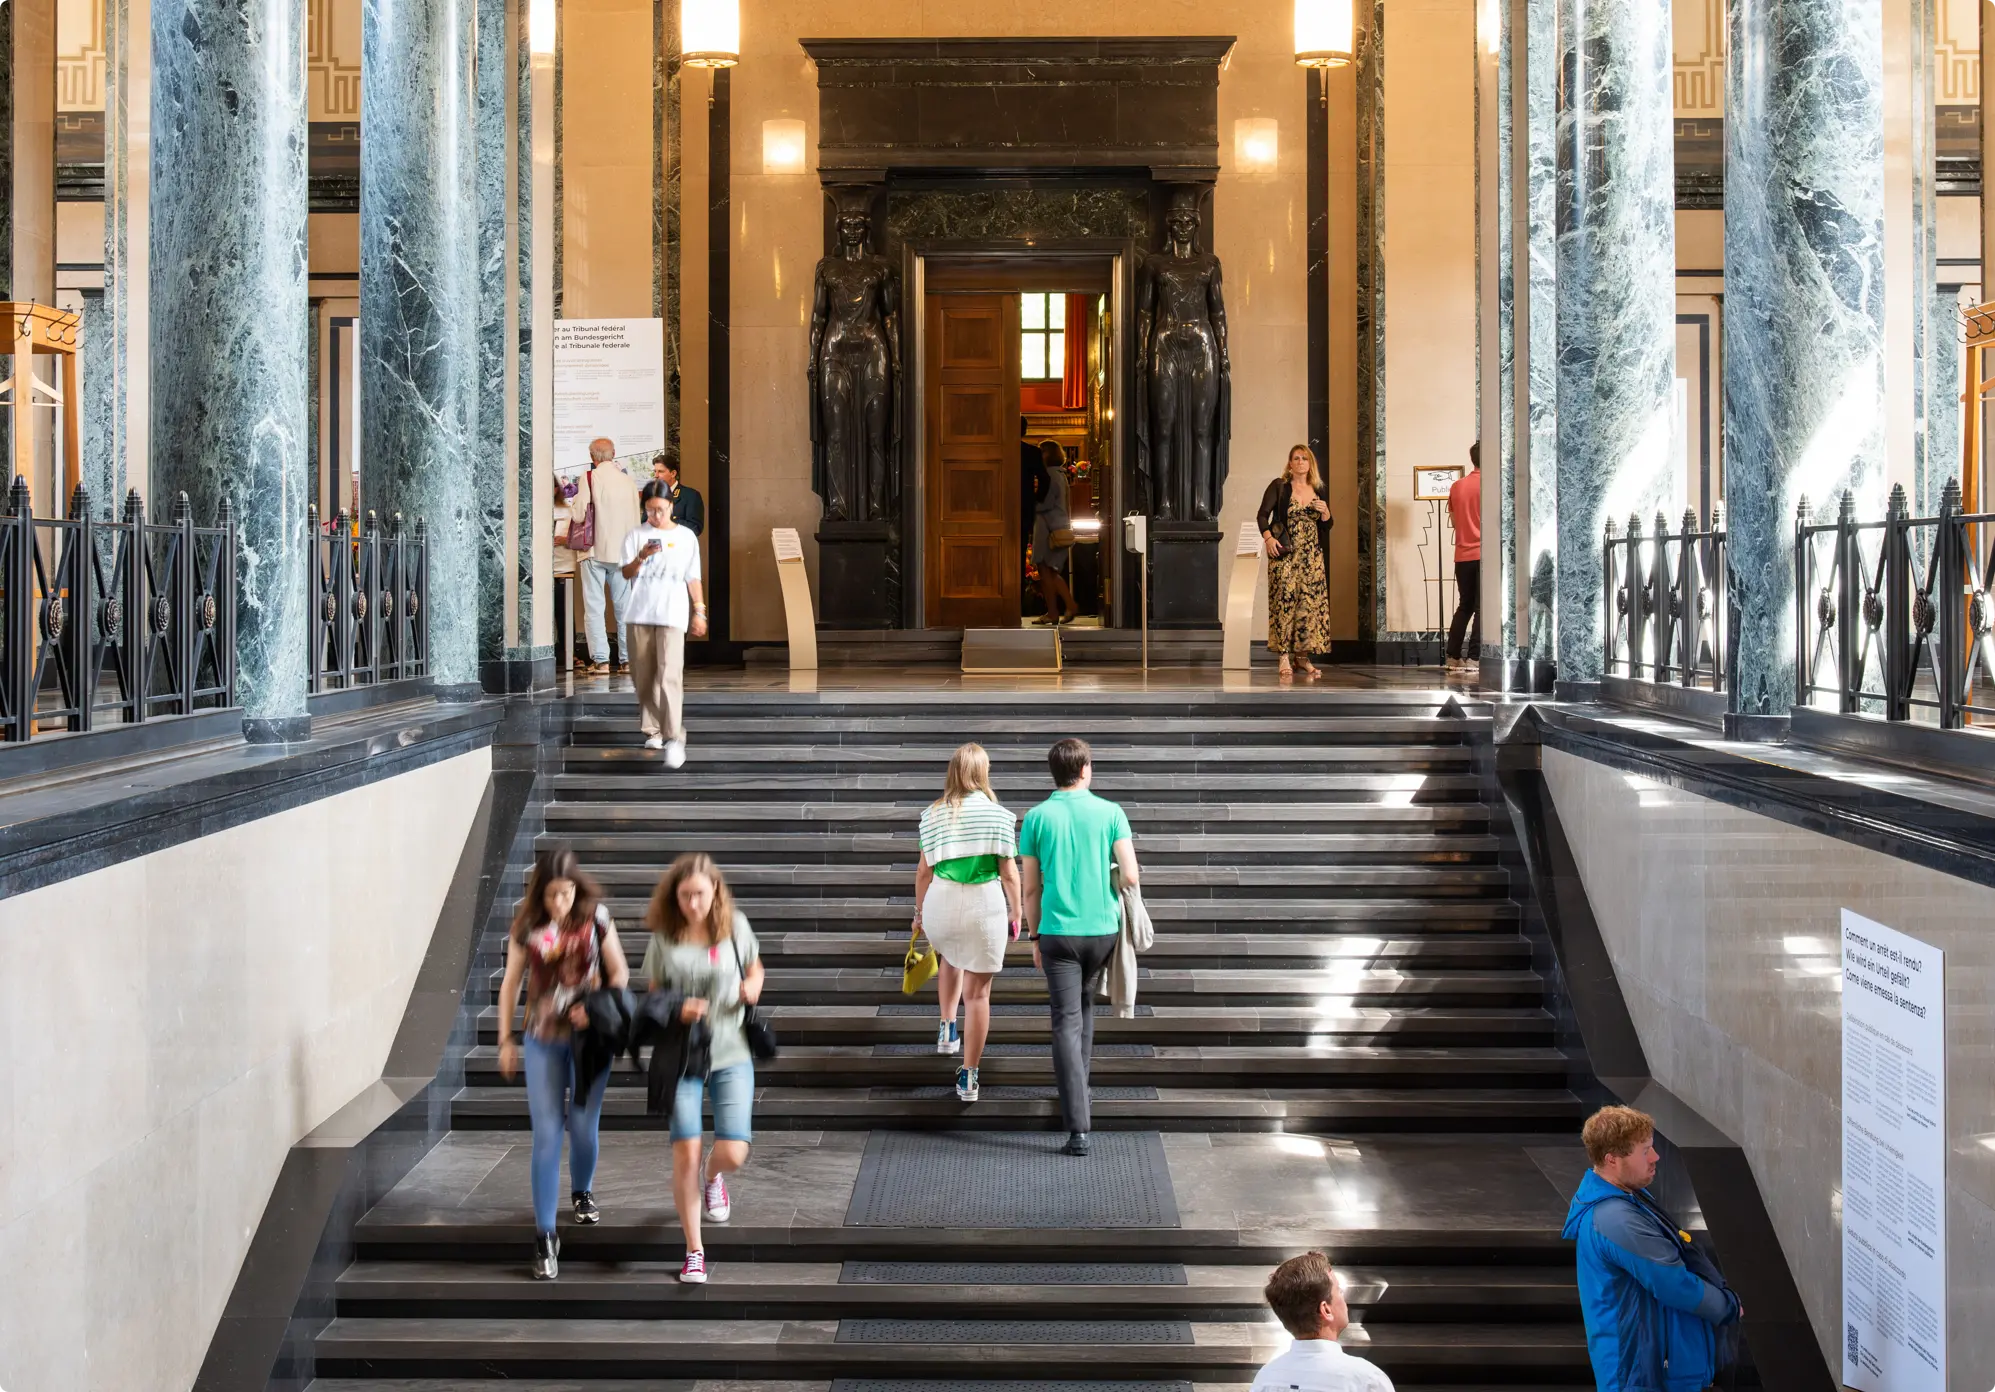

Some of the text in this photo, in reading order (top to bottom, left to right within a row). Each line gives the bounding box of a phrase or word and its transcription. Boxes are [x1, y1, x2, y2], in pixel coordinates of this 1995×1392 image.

[574, 334, 624, 342] Bundesgericht
[1845, 927, 1922, 973] Comment un arrêt est-il rendu?
[1845, 947, 1910, 989] Wie wird ein Urteil gefällt?
[1845, 967, 1926, 1020] Come viene emessa la sentenza?
